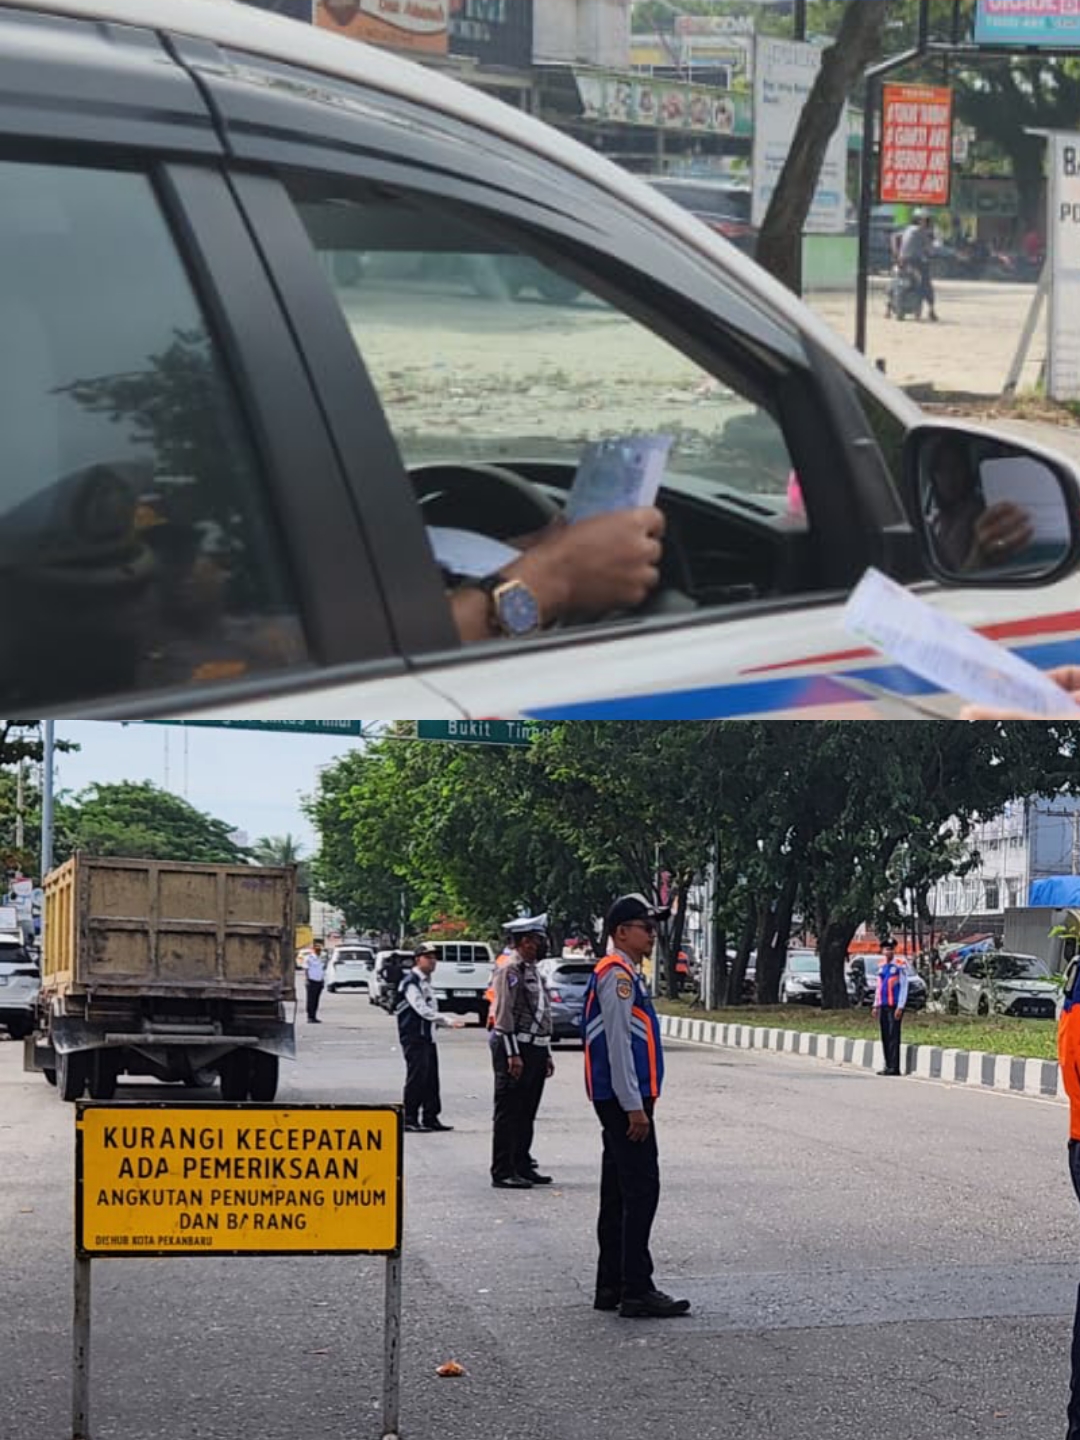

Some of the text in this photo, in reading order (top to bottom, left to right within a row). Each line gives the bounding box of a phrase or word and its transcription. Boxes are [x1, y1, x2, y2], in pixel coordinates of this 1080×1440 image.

[448, 720, 491, 737] Bukit
[103, 1126, 383, 1151] KURANGI KECEPATAN
[118, 1156, 359, 1180] ADA PEMERIKSAAN
[97, 1189, 387, 1207] ANGKUTAN PENUMPANG UMUM
[179, 1213, 219, 1230] DAN
[132, 1235, 155, 1246] KOTA
[157, 1235, 213, 1246] PEKANBARU
